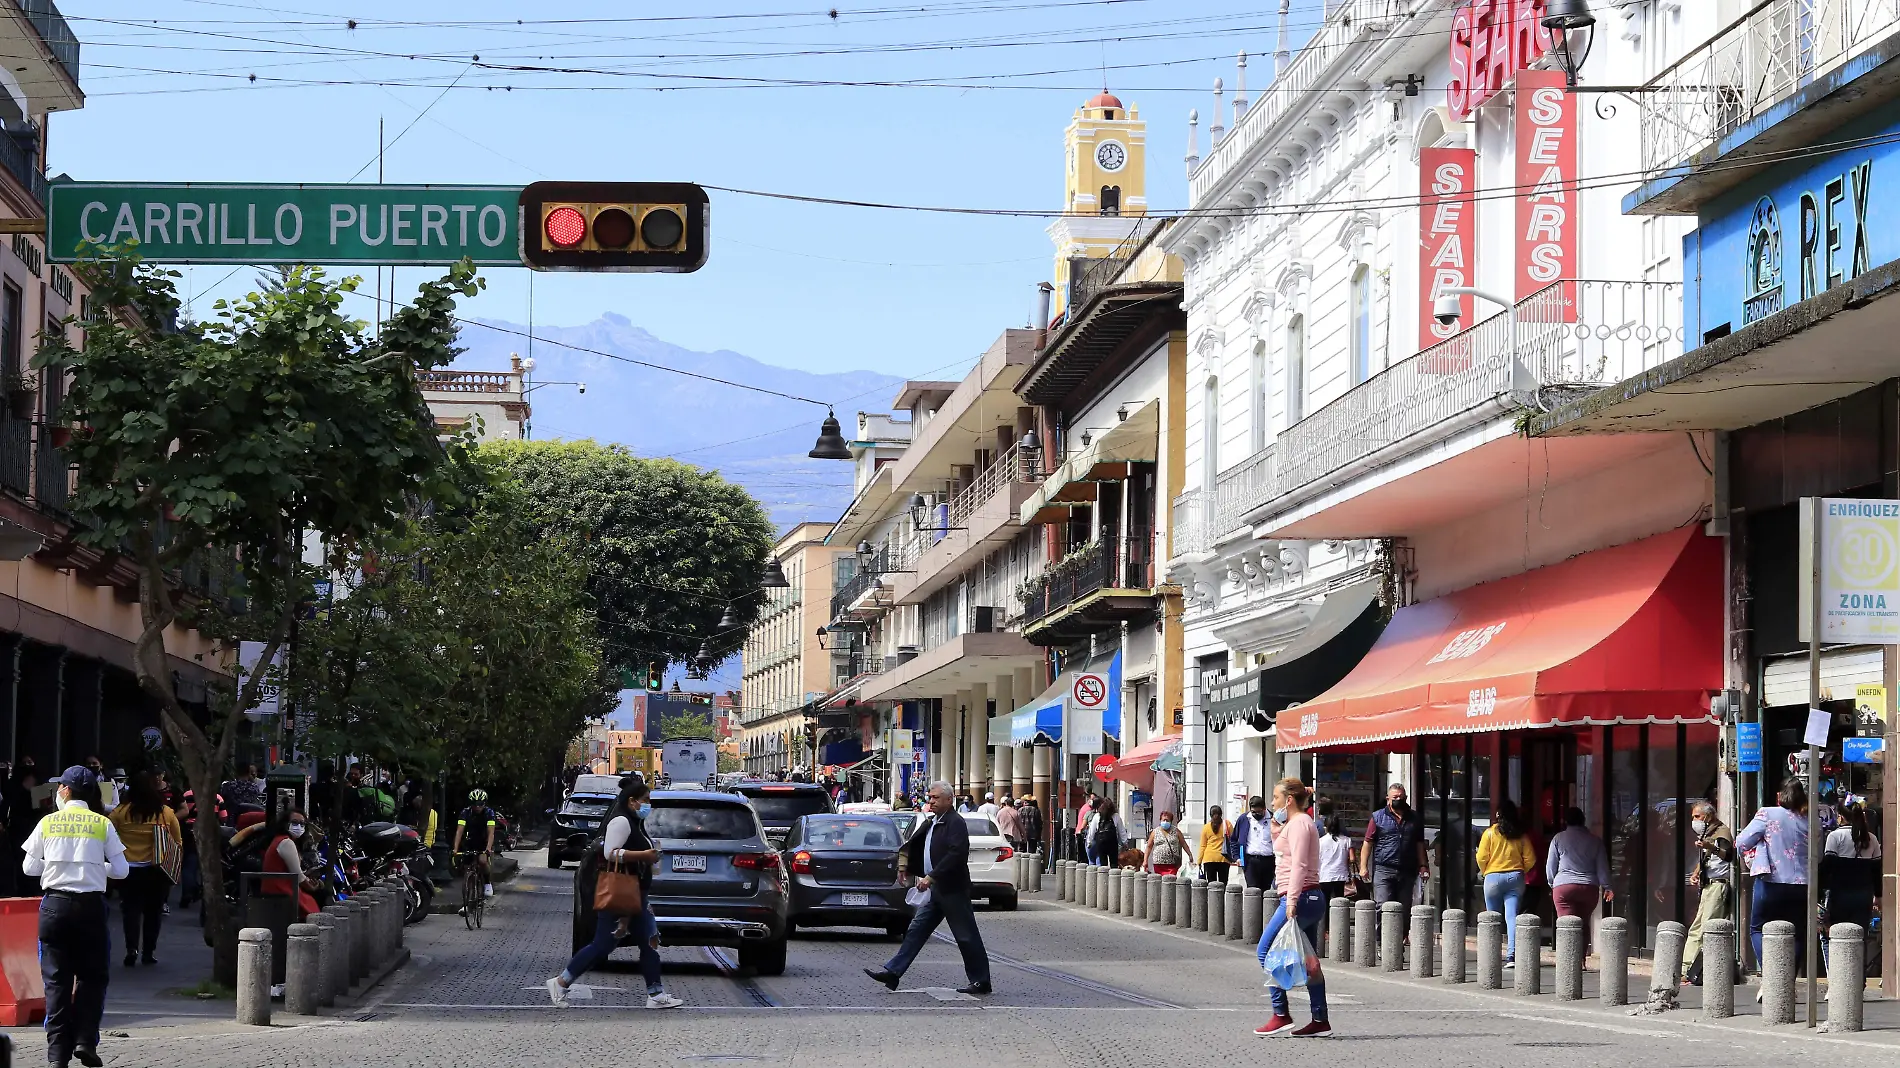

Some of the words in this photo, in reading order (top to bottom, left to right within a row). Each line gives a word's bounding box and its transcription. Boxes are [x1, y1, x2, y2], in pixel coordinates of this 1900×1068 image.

[1527, 87, 1566, 283] SEARS
[79, 201, 302, 246] CARRILLO
[328, 203, 508, 247] PUERTO
[1800, 159, 1872, 301] REX
[1829, 502, 1899, 517] ENRÍQUEZ
[1845, 533, 1883, 566] 30
[1840, 594, 1887, 609] ZONA
[1857, 688, 1882, 696] UNEFON
[49, 823, 96, 834] ESTATAL
